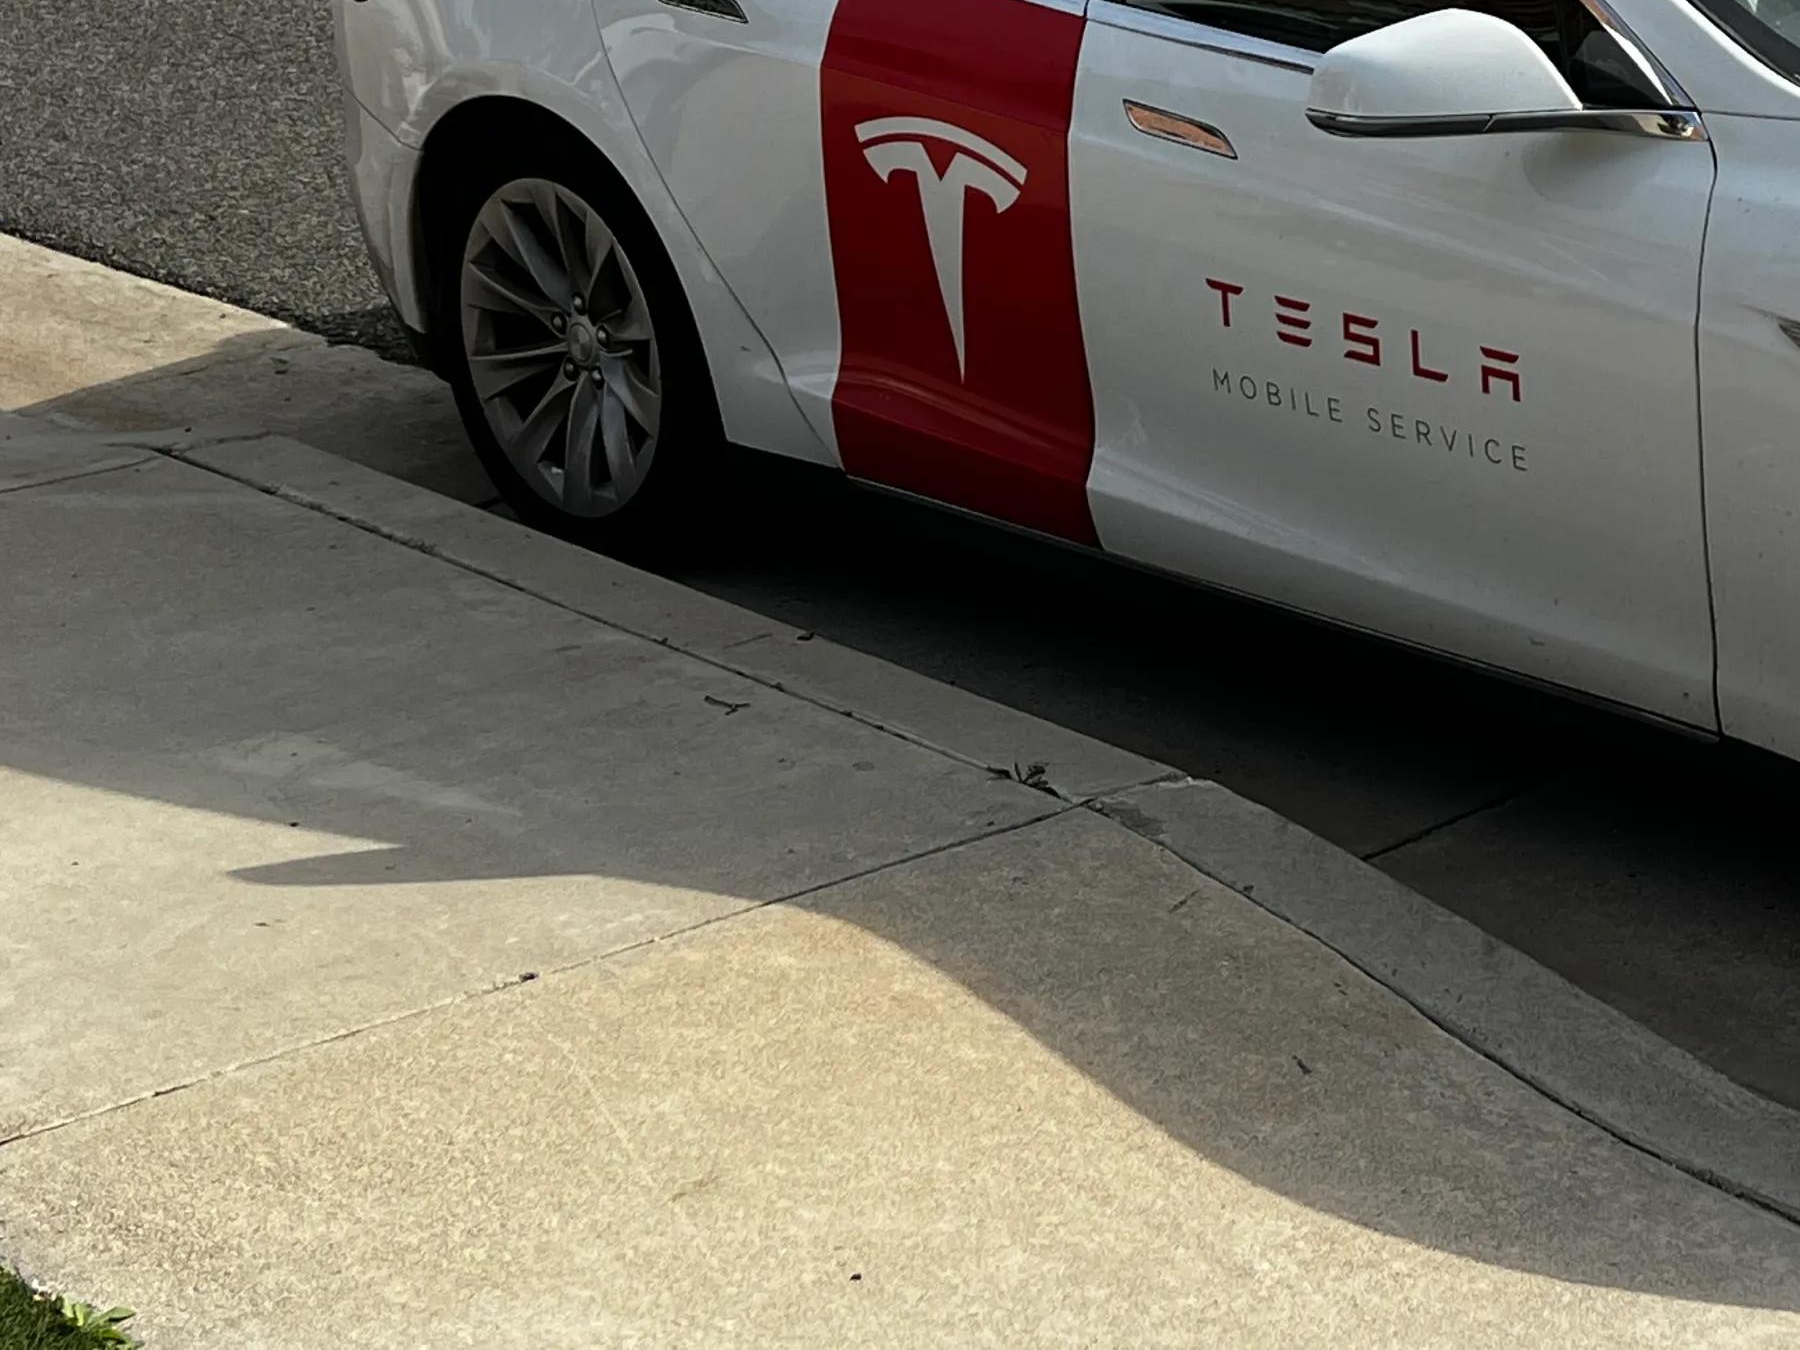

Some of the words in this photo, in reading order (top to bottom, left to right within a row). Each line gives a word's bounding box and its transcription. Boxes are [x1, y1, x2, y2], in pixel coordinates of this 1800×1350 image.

[1205, 278, 1521, 402] TESLA
[1212, 367, 1343, 424] MOBILE
[1367, 408, 1529, 472] SERVICE
